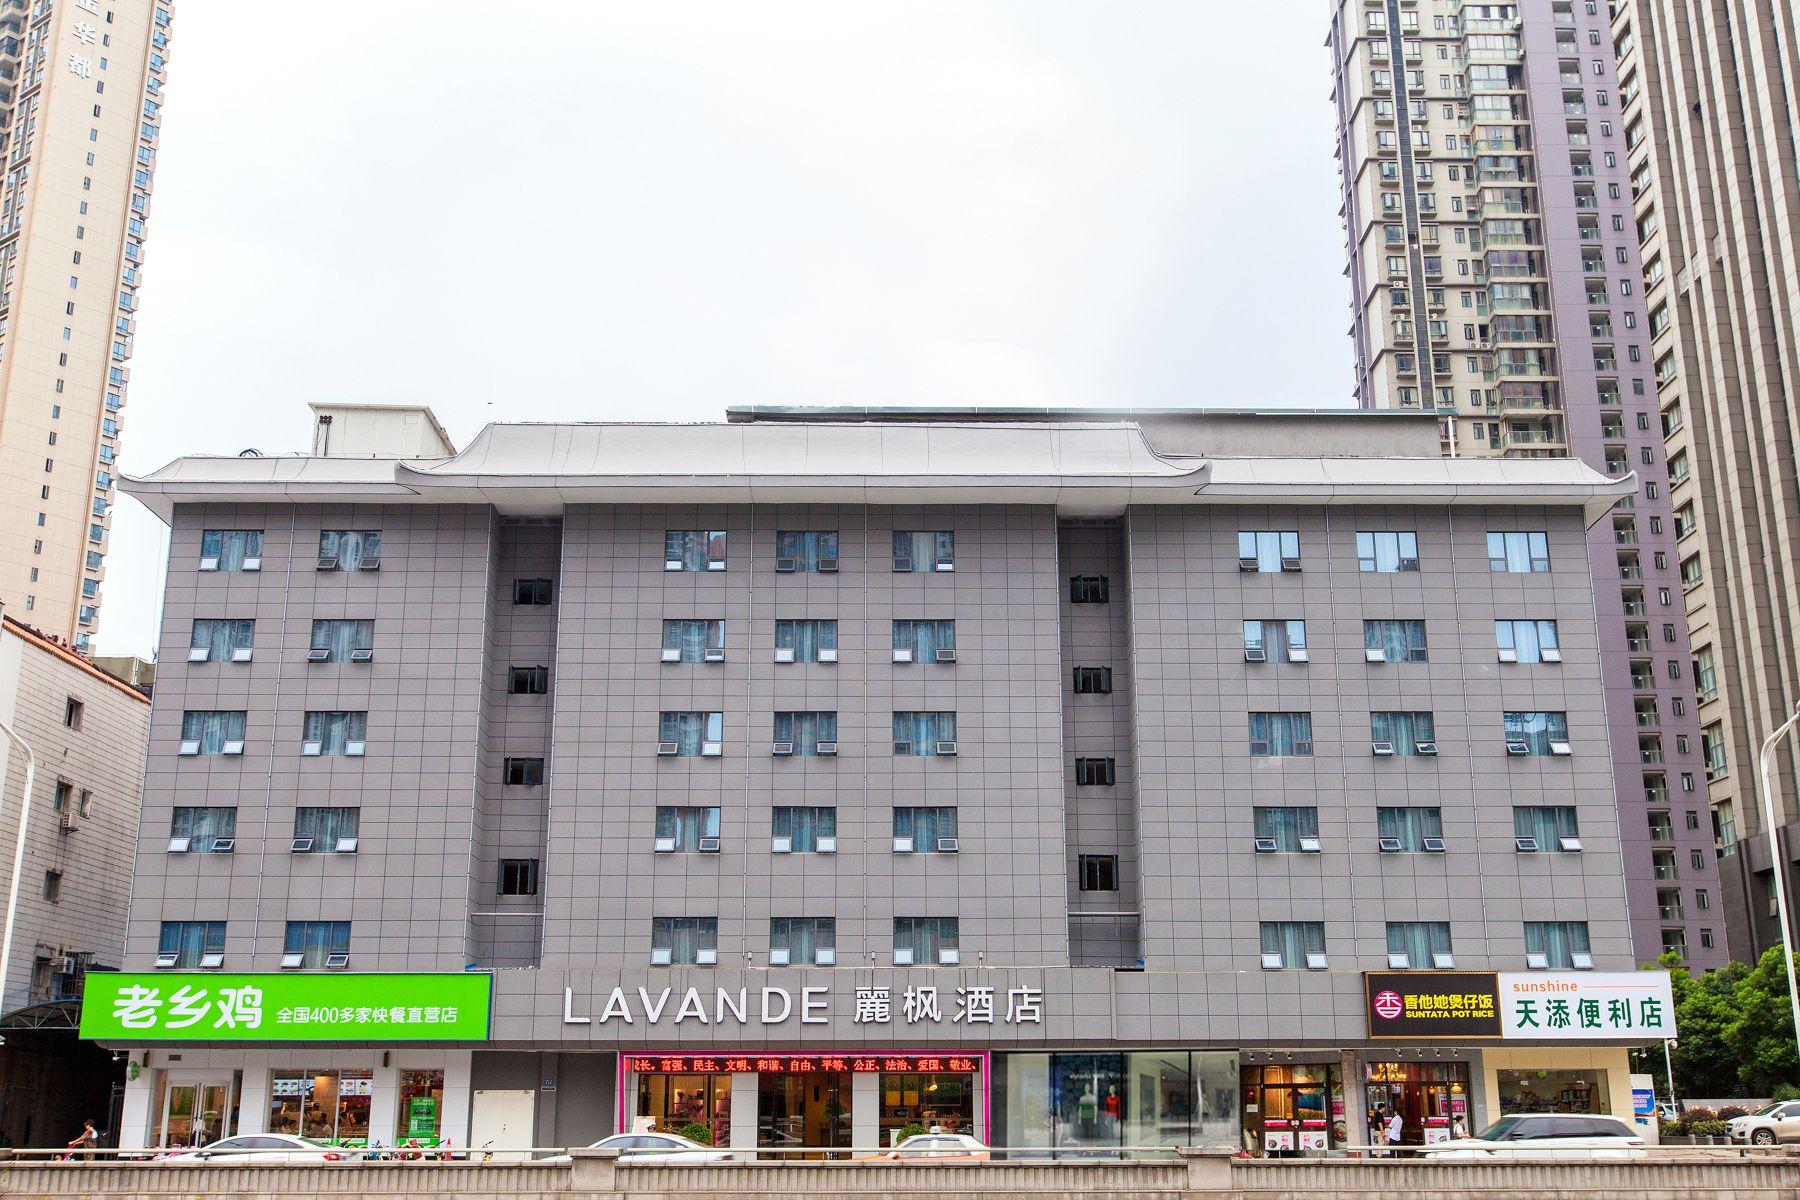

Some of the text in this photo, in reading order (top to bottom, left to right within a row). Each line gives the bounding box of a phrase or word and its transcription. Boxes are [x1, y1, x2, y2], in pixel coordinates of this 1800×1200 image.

[1513, 980, 1578, 992] sunshine
[112, 984, 263, 1030] 老乡鸡
[563, 985, 830, 1025] LAVANDE
[853, 985, 1042, 1025] 麗枫酒店
[1404, 994, 1494, 1010] 香他她煲仔饭
[1405, 1010, 1495, 1018] SUNTATA POT RICE
[1516, 997, 1662, 1028] 天添便利店
[276, 1006, 458, 1024] 全国400多家快餐直营店
